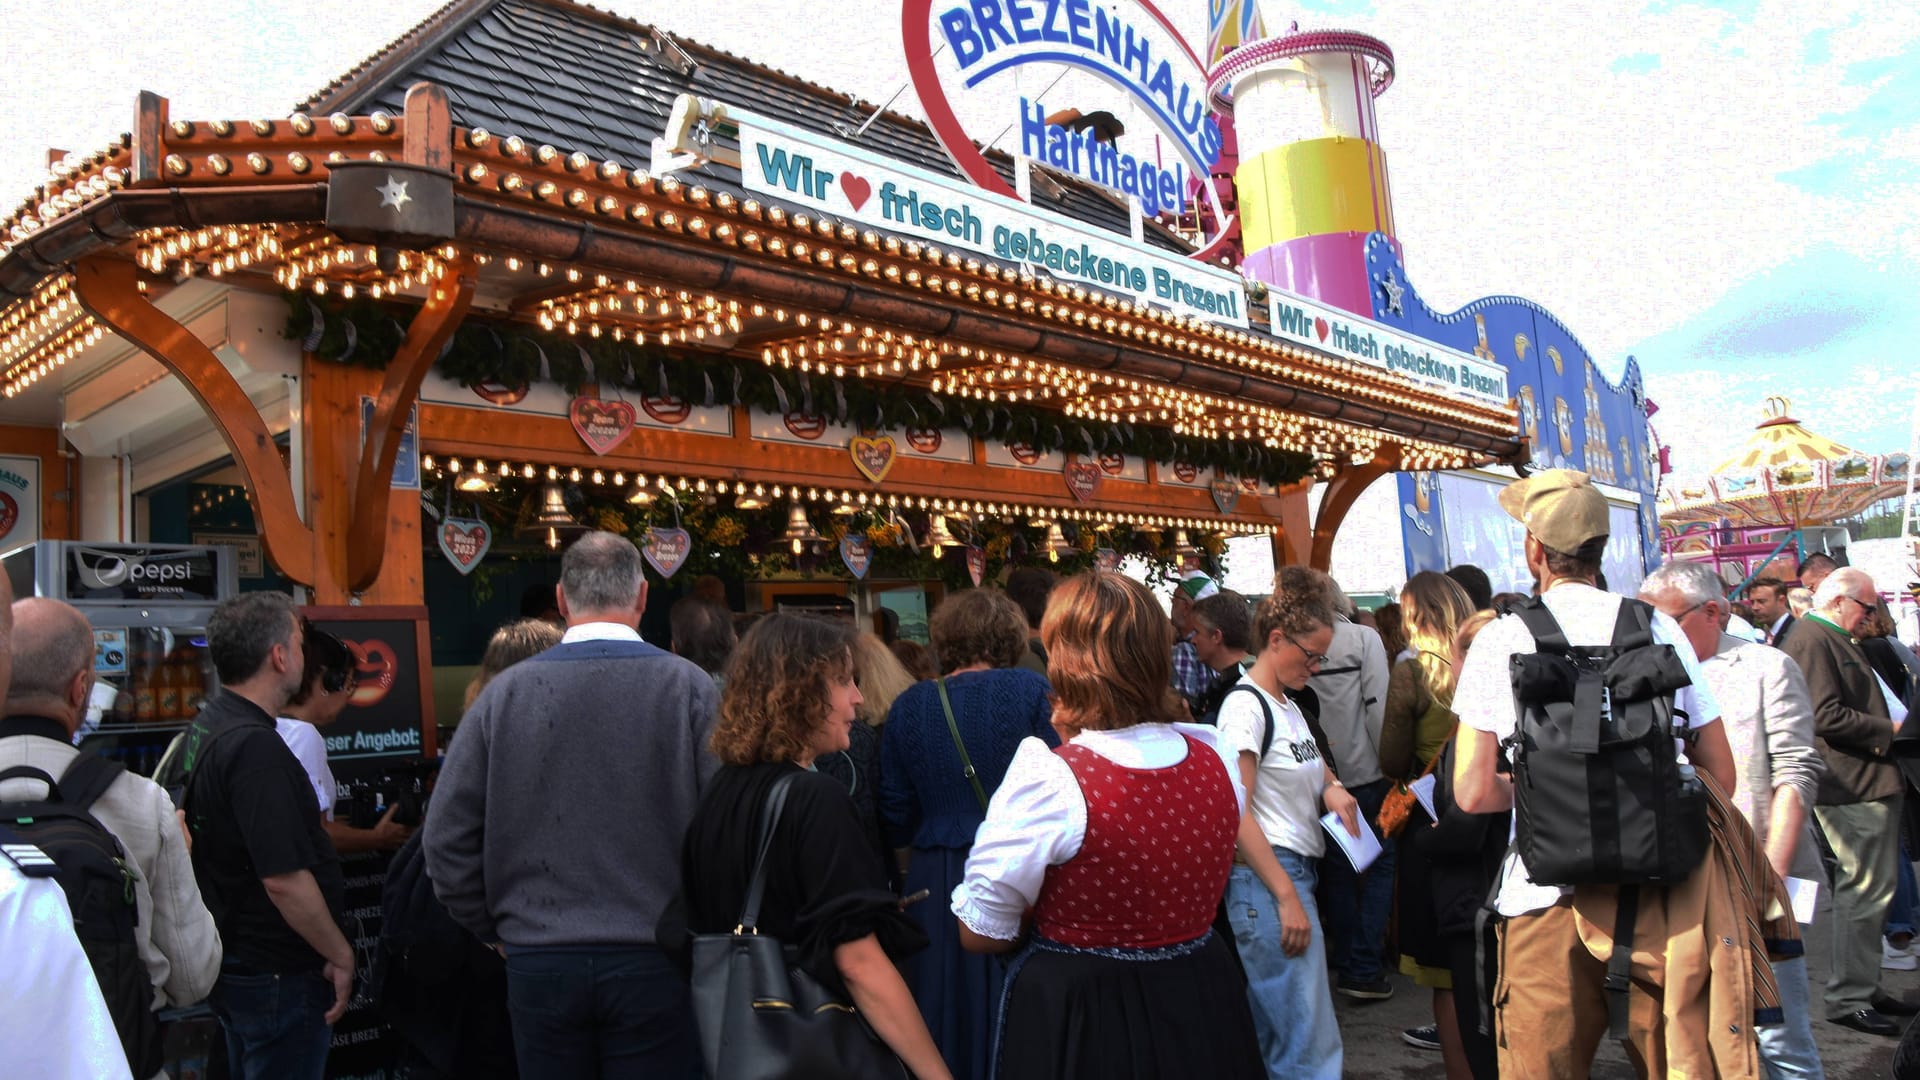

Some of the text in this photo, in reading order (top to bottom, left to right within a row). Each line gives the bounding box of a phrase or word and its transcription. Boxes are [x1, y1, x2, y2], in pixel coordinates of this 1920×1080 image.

[939, 0, 1223, 166] BREZENHAUS
[1019, 96, 1185, 217] Hartnagel
[756, 142, 1239, 319] Wir frisch gebackene Brezen!
[1277, 302, 1504, 399] Wir frisch gebackene Brezen!
[131, 560, 191, 583] pepsi
[325, 728, 420, 752] ser Angebot:
